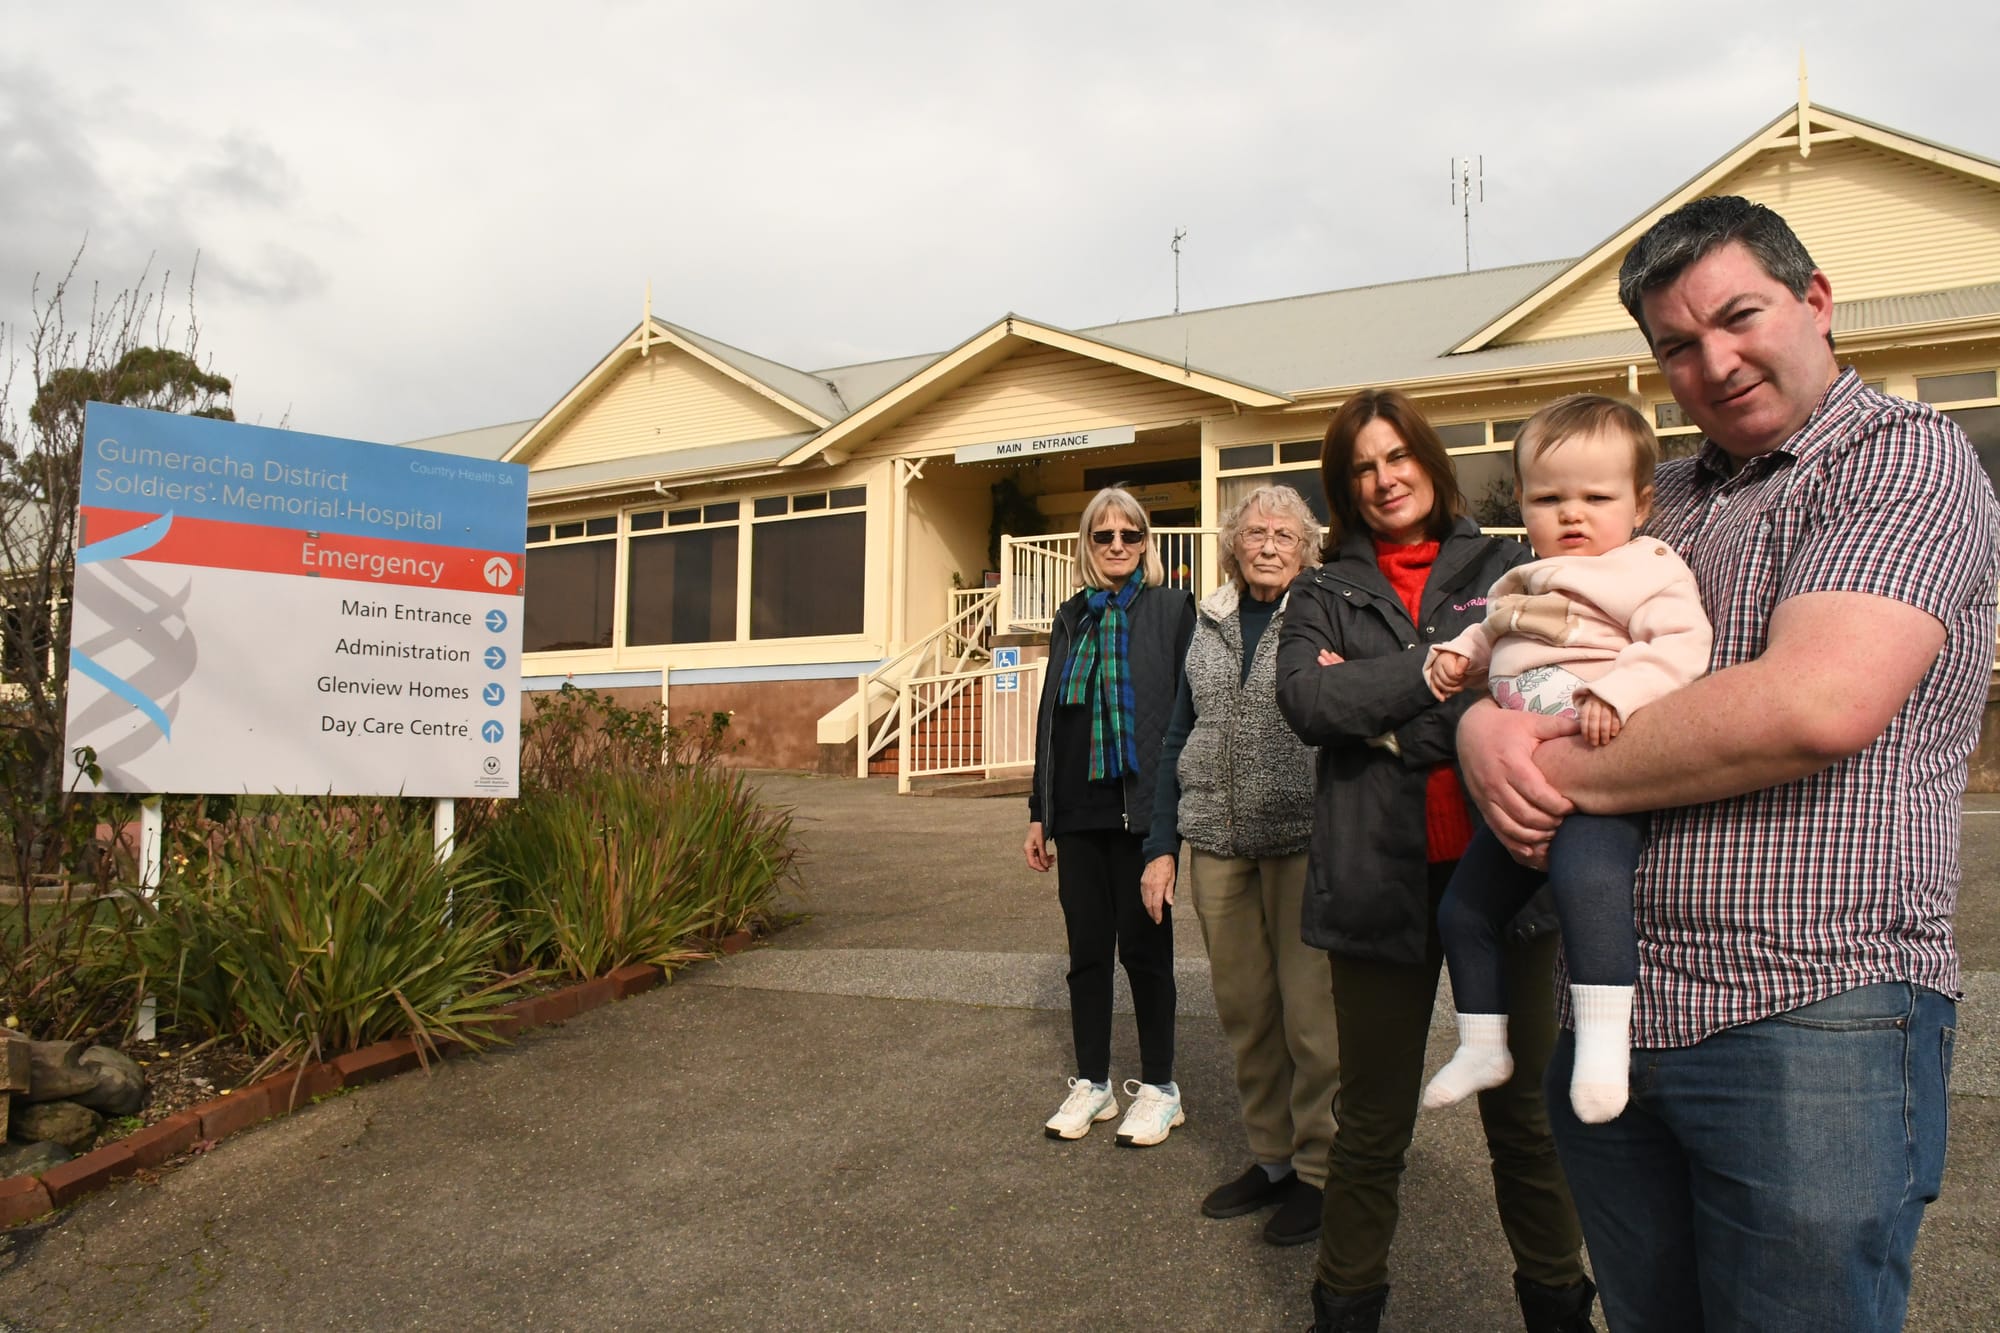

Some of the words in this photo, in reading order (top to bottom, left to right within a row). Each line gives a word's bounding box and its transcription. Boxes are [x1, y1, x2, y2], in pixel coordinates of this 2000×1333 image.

[996, 443, 1022, 455] MAIN
[1032, 434, 1089, 450] ENTRANCE
[97, 438, 254, 479] Gumeracha
[264, 460, 349, 492] District
[409, 461, 455, 480] Country
[458, 468, 495, 483] Health
[498, 473, 513, 485] SA
[95, 468, 214, 503] Soldiers'
[222, 485, 339, 519] Memorial
[348, 500, 442, 531] Hospital
[302, 542, 445, 583] Emergency
[341, 600, 387, 618] Main
[395, 604, 472, 625] Entrance
[335, 638, 470, 662] Administration
[317, 675, 403, 696] Glenview
[409, 681, 469, 700] Homes
[321, 716, 357, 737] Day
[363, 717, 404, 735] Care
[410, 719, 468, 737] Centre
